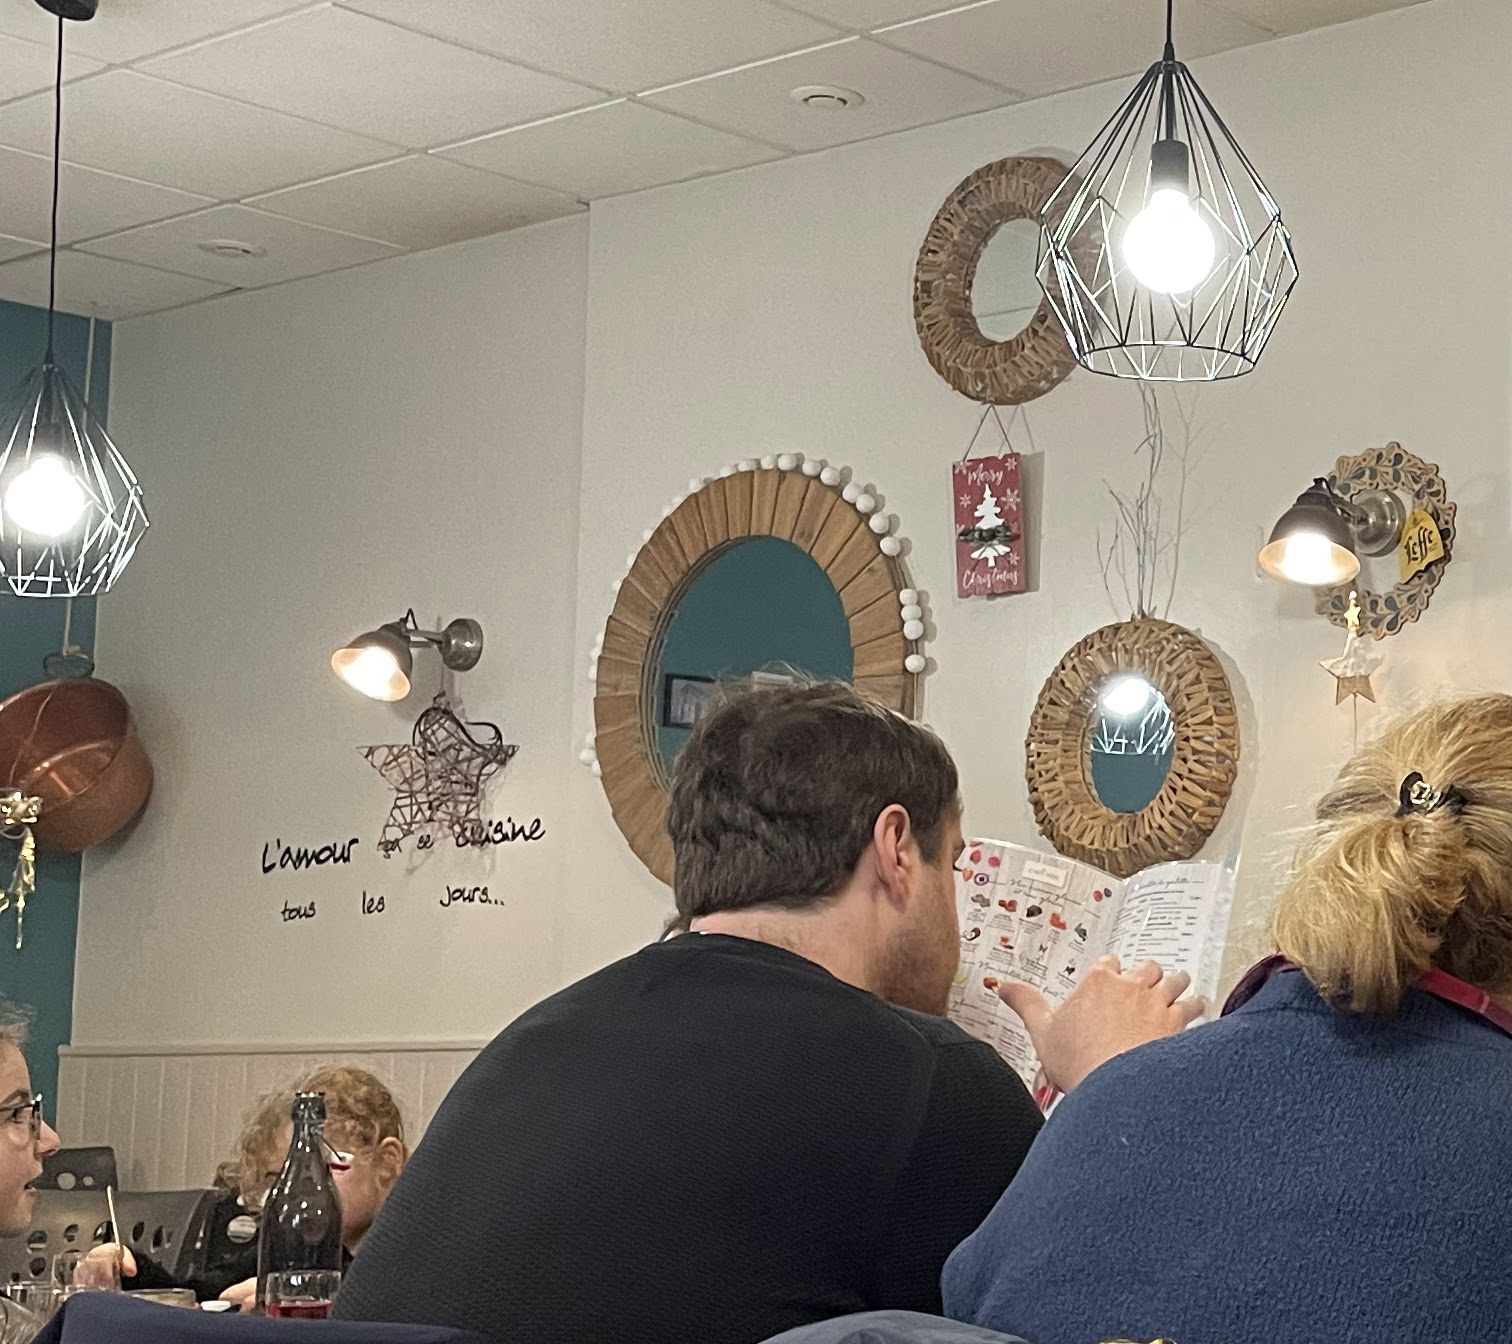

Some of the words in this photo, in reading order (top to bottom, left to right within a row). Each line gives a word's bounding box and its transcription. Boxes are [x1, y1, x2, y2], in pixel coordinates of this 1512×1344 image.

[1404, 525, 1434, 566] Leffe
[262, 837, 359, 874] L'amour
[281, 900, 316, 922] tous
[362, 890, 385, 915] les
